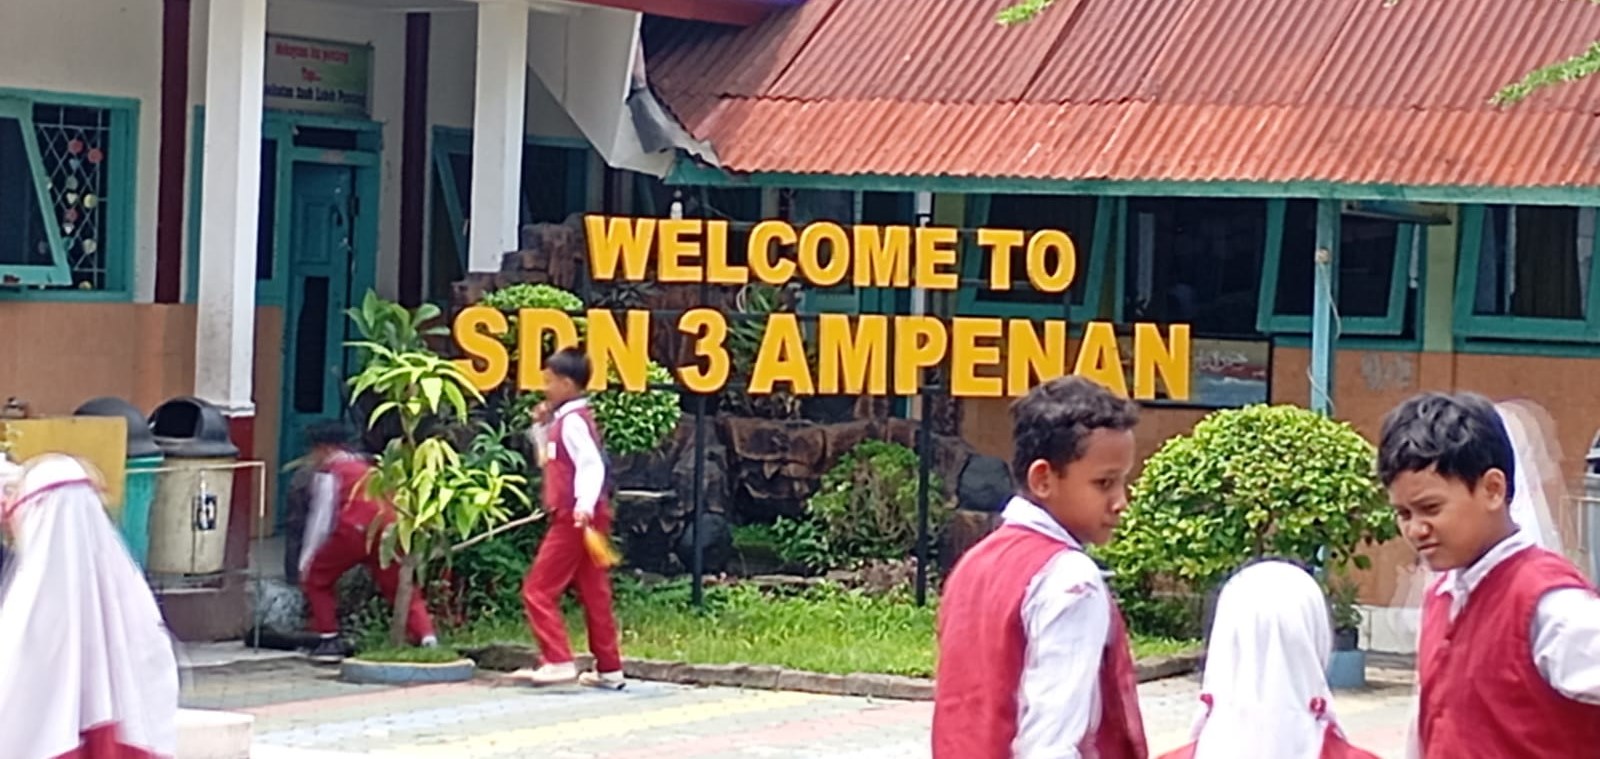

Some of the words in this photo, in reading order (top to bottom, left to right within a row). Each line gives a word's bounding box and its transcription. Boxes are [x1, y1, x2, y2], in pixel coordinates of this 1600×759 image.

[584, 213, 959, 289] WELCOME
[977, 228, 1077, 293] TO
[453, 306, 650, 392] SDN
[677, 308, 730, 393] 3
[747, 312, 1191, 400] AMPENAN
